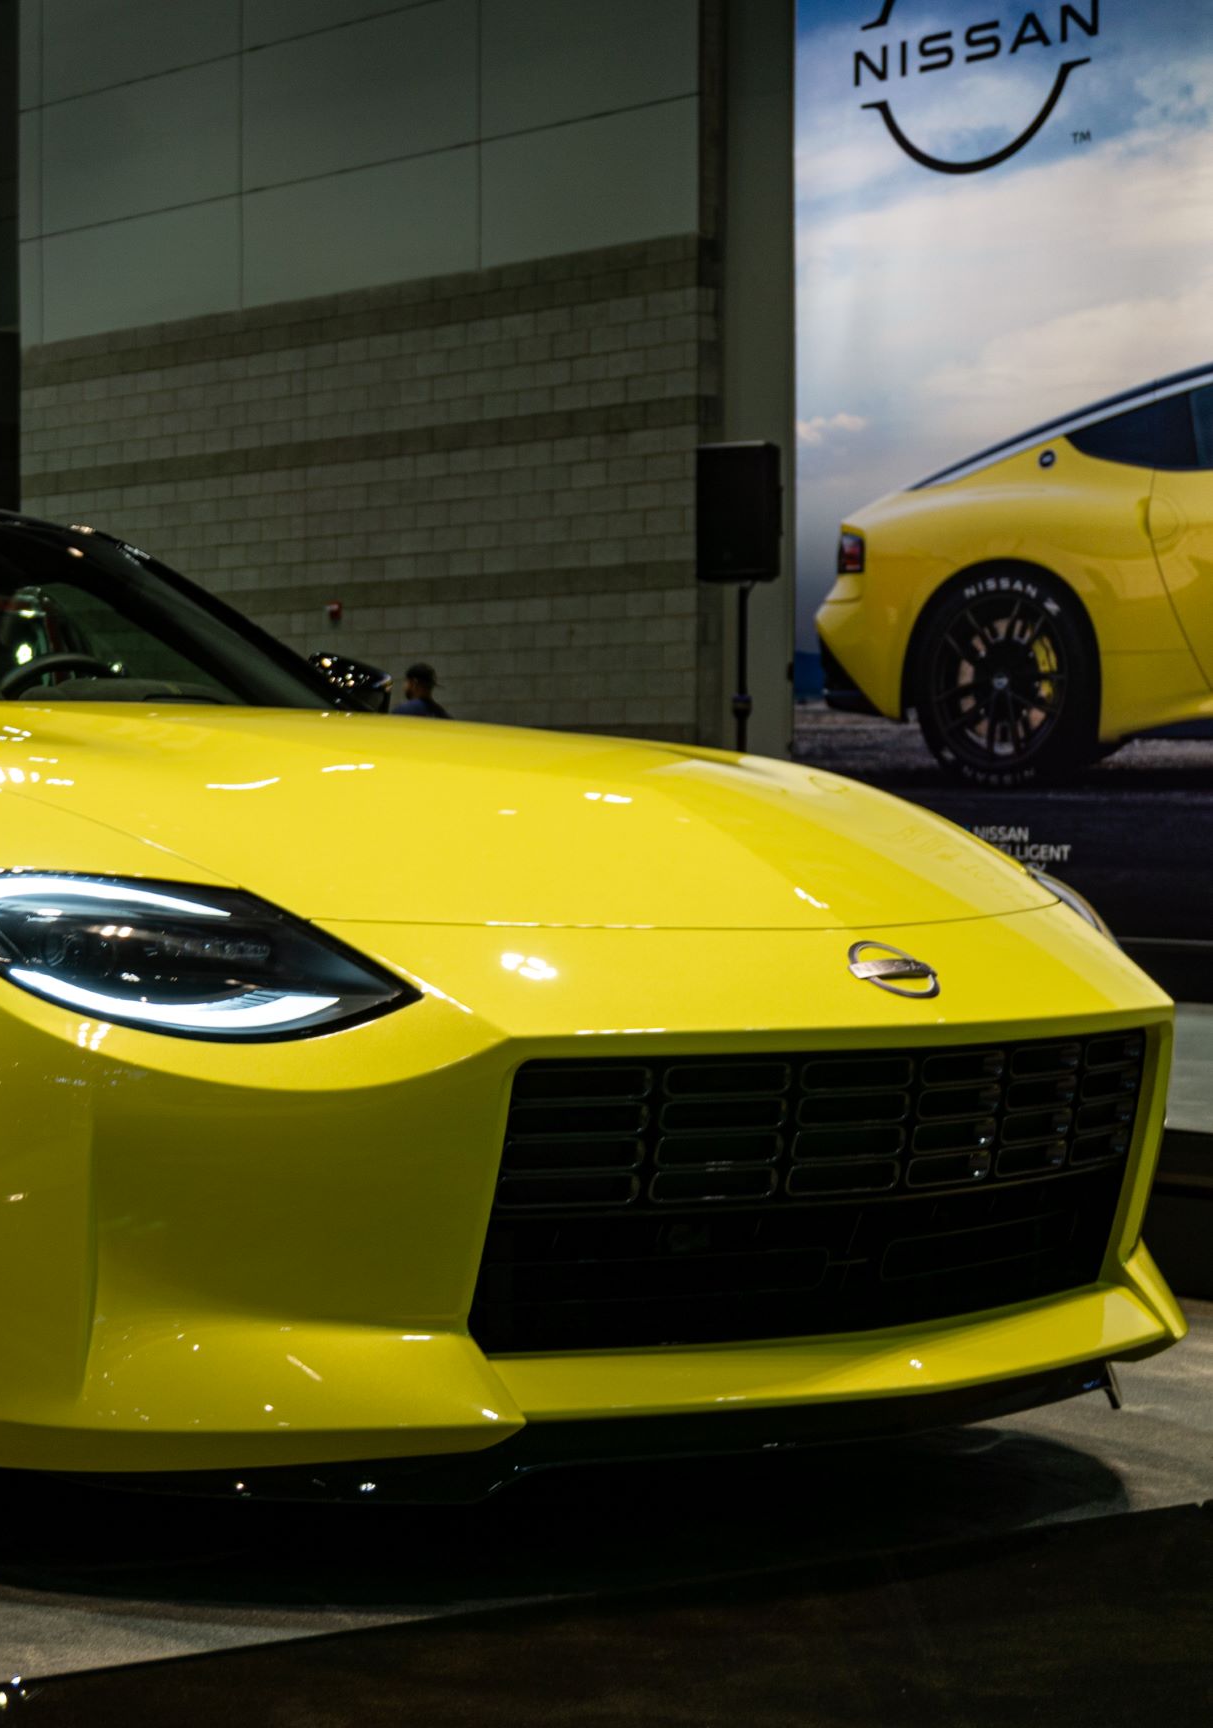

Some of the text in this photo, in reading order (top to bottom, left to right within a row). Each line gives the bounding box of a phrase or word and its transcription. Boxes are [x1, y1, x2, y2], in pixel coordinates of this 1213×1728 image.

[853, 0, 1099, 87] NISSAN
[963, 577, 1039, 599] NISSAN
[973, 825, 1030, 843] NISSAN
